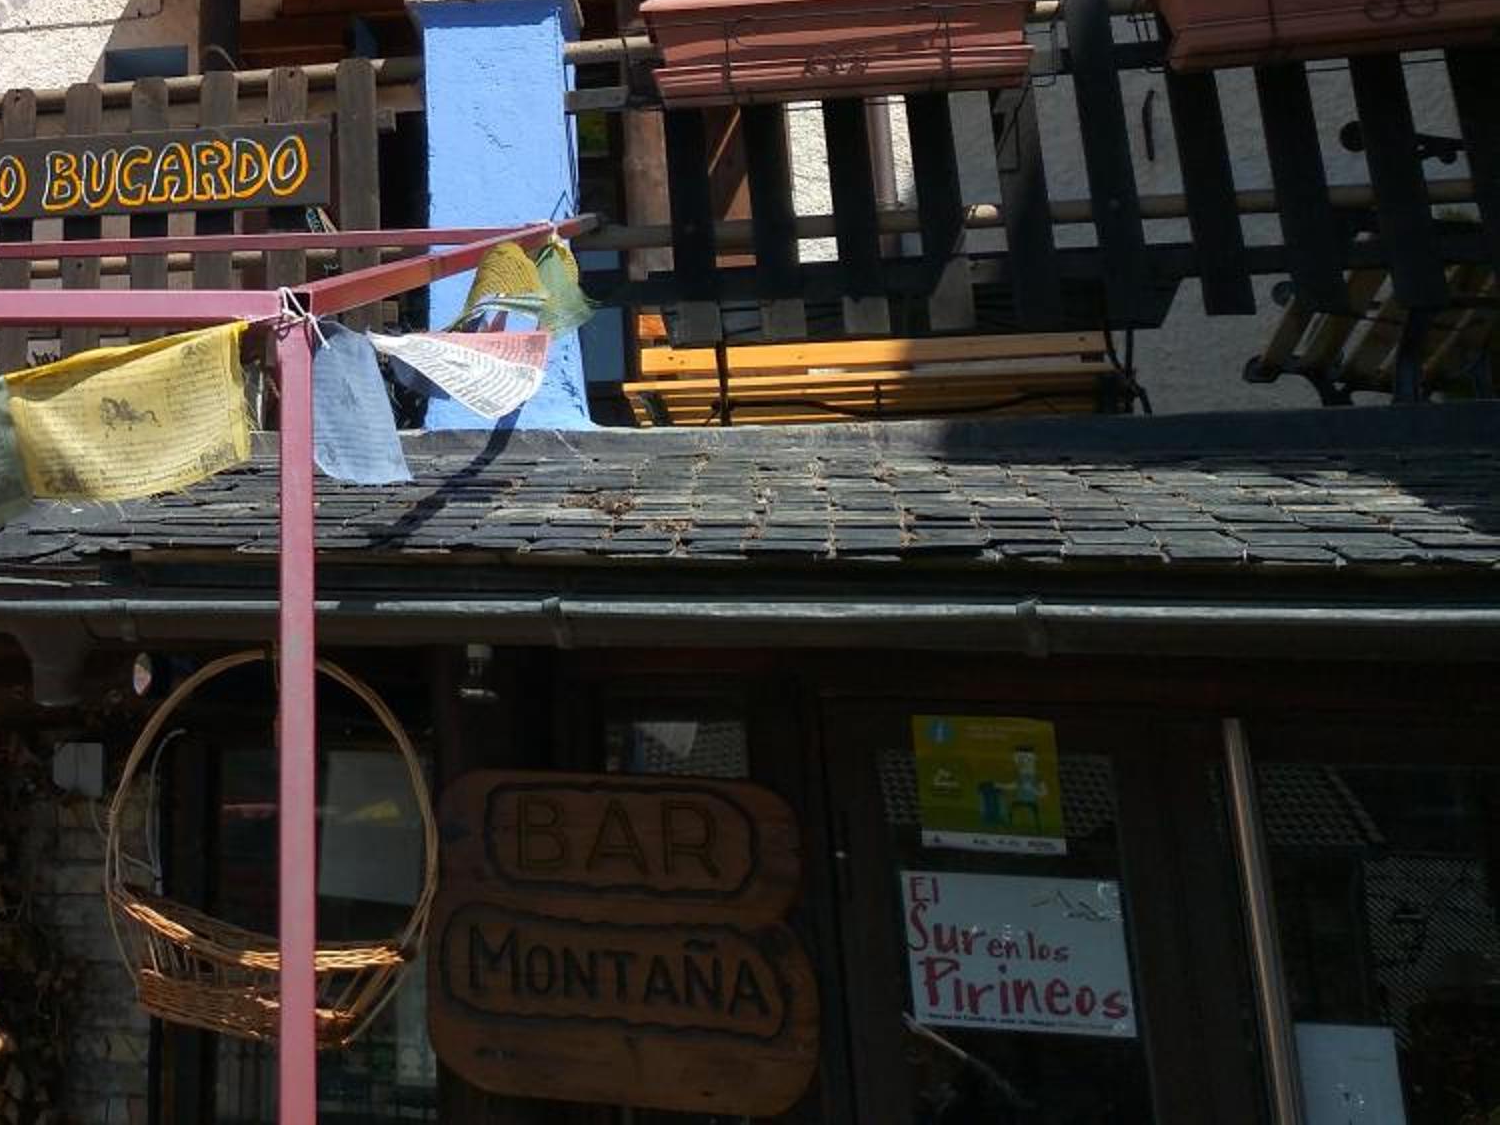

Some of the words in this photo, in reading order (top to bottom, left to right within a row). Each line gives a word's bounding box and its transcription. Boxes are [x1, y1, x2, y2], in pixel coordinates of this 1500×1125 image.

[41, 135, 309, 211] BUCARDO
[516, 794, 723, 877] BAR
[909, 876, 939, 904] El
[906, 902, 986, 955] Sur
[987, 937, 1023, 960] en
[1027, 931, 1071, 962] los
[468, 922, 770, 1017] MONTAÑA
[917, 956, 1130, 1019] Pirineos
